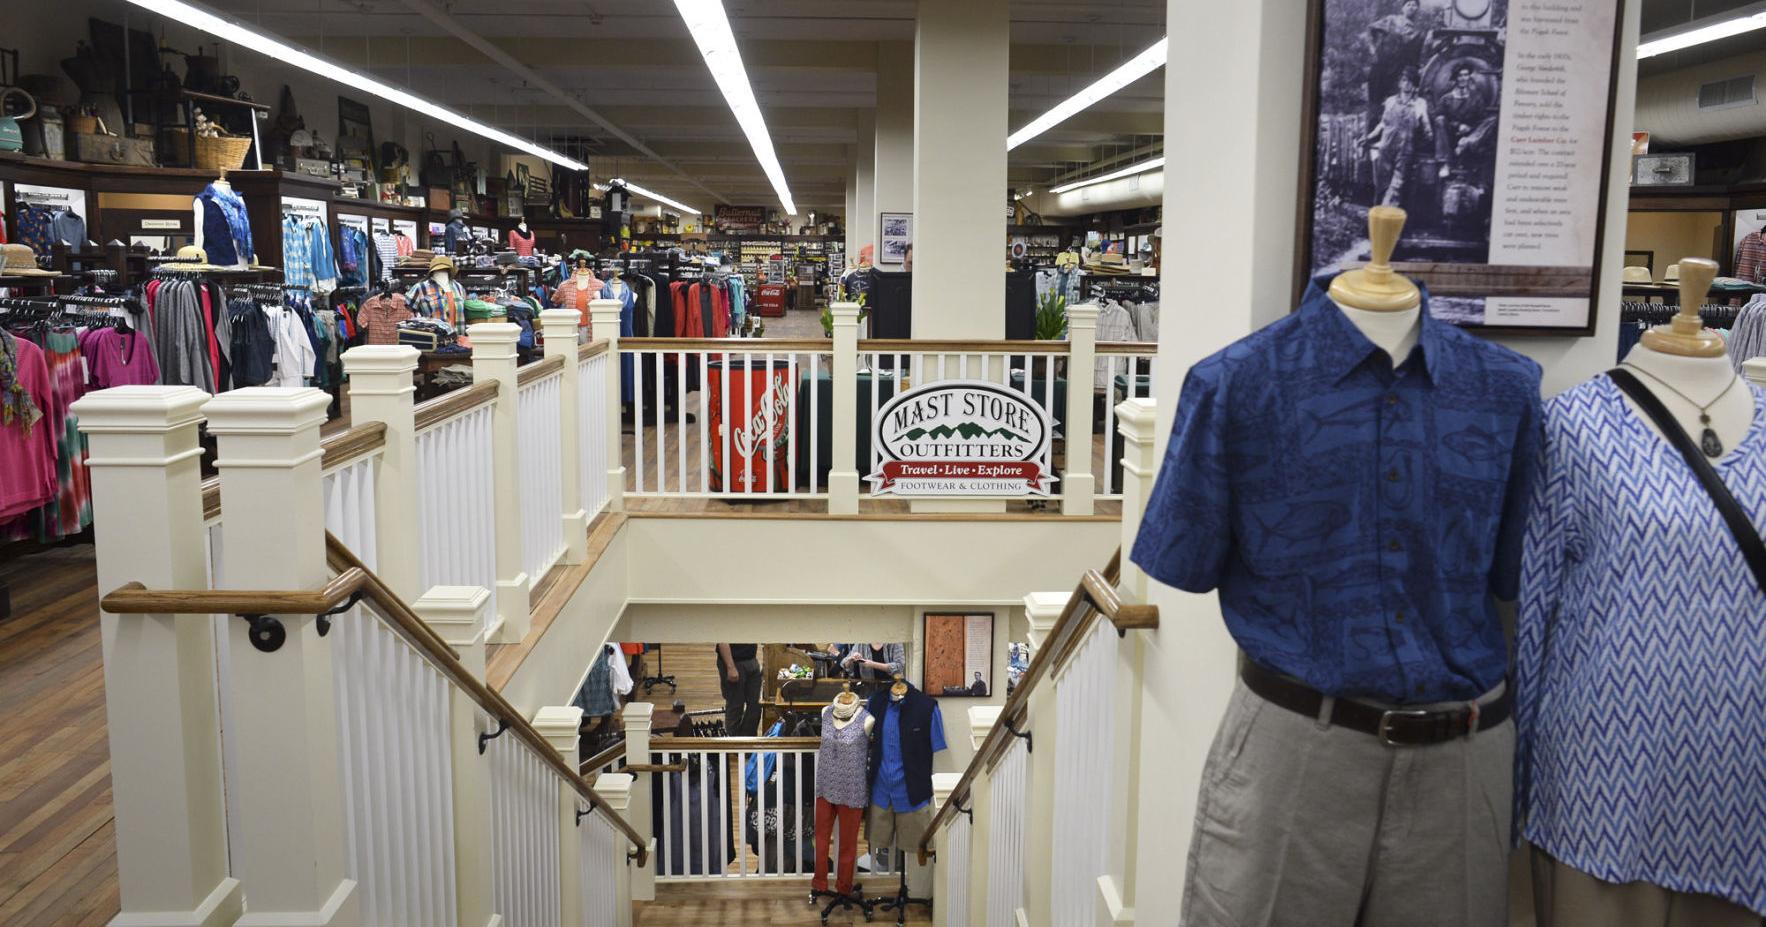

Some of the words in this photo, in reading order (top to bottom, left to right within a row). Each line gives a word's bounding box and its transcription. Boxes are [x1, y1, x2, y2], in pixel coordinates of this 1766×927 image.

[893, 393, 954, 434] MAST
[963, 392, 1030, 434] STORE
[899, 443, 1024, 458] OUTFITTERS
[900, 464, 938, 475] Travel
[944, 464, 970, 475] Live
[977, 464, 1023, 477] Explore
[900, 481, 956, 490] FOOTWEAR
[959, 481, 968, 490] &
[970, 481, 1022, 490] CLOTHING
